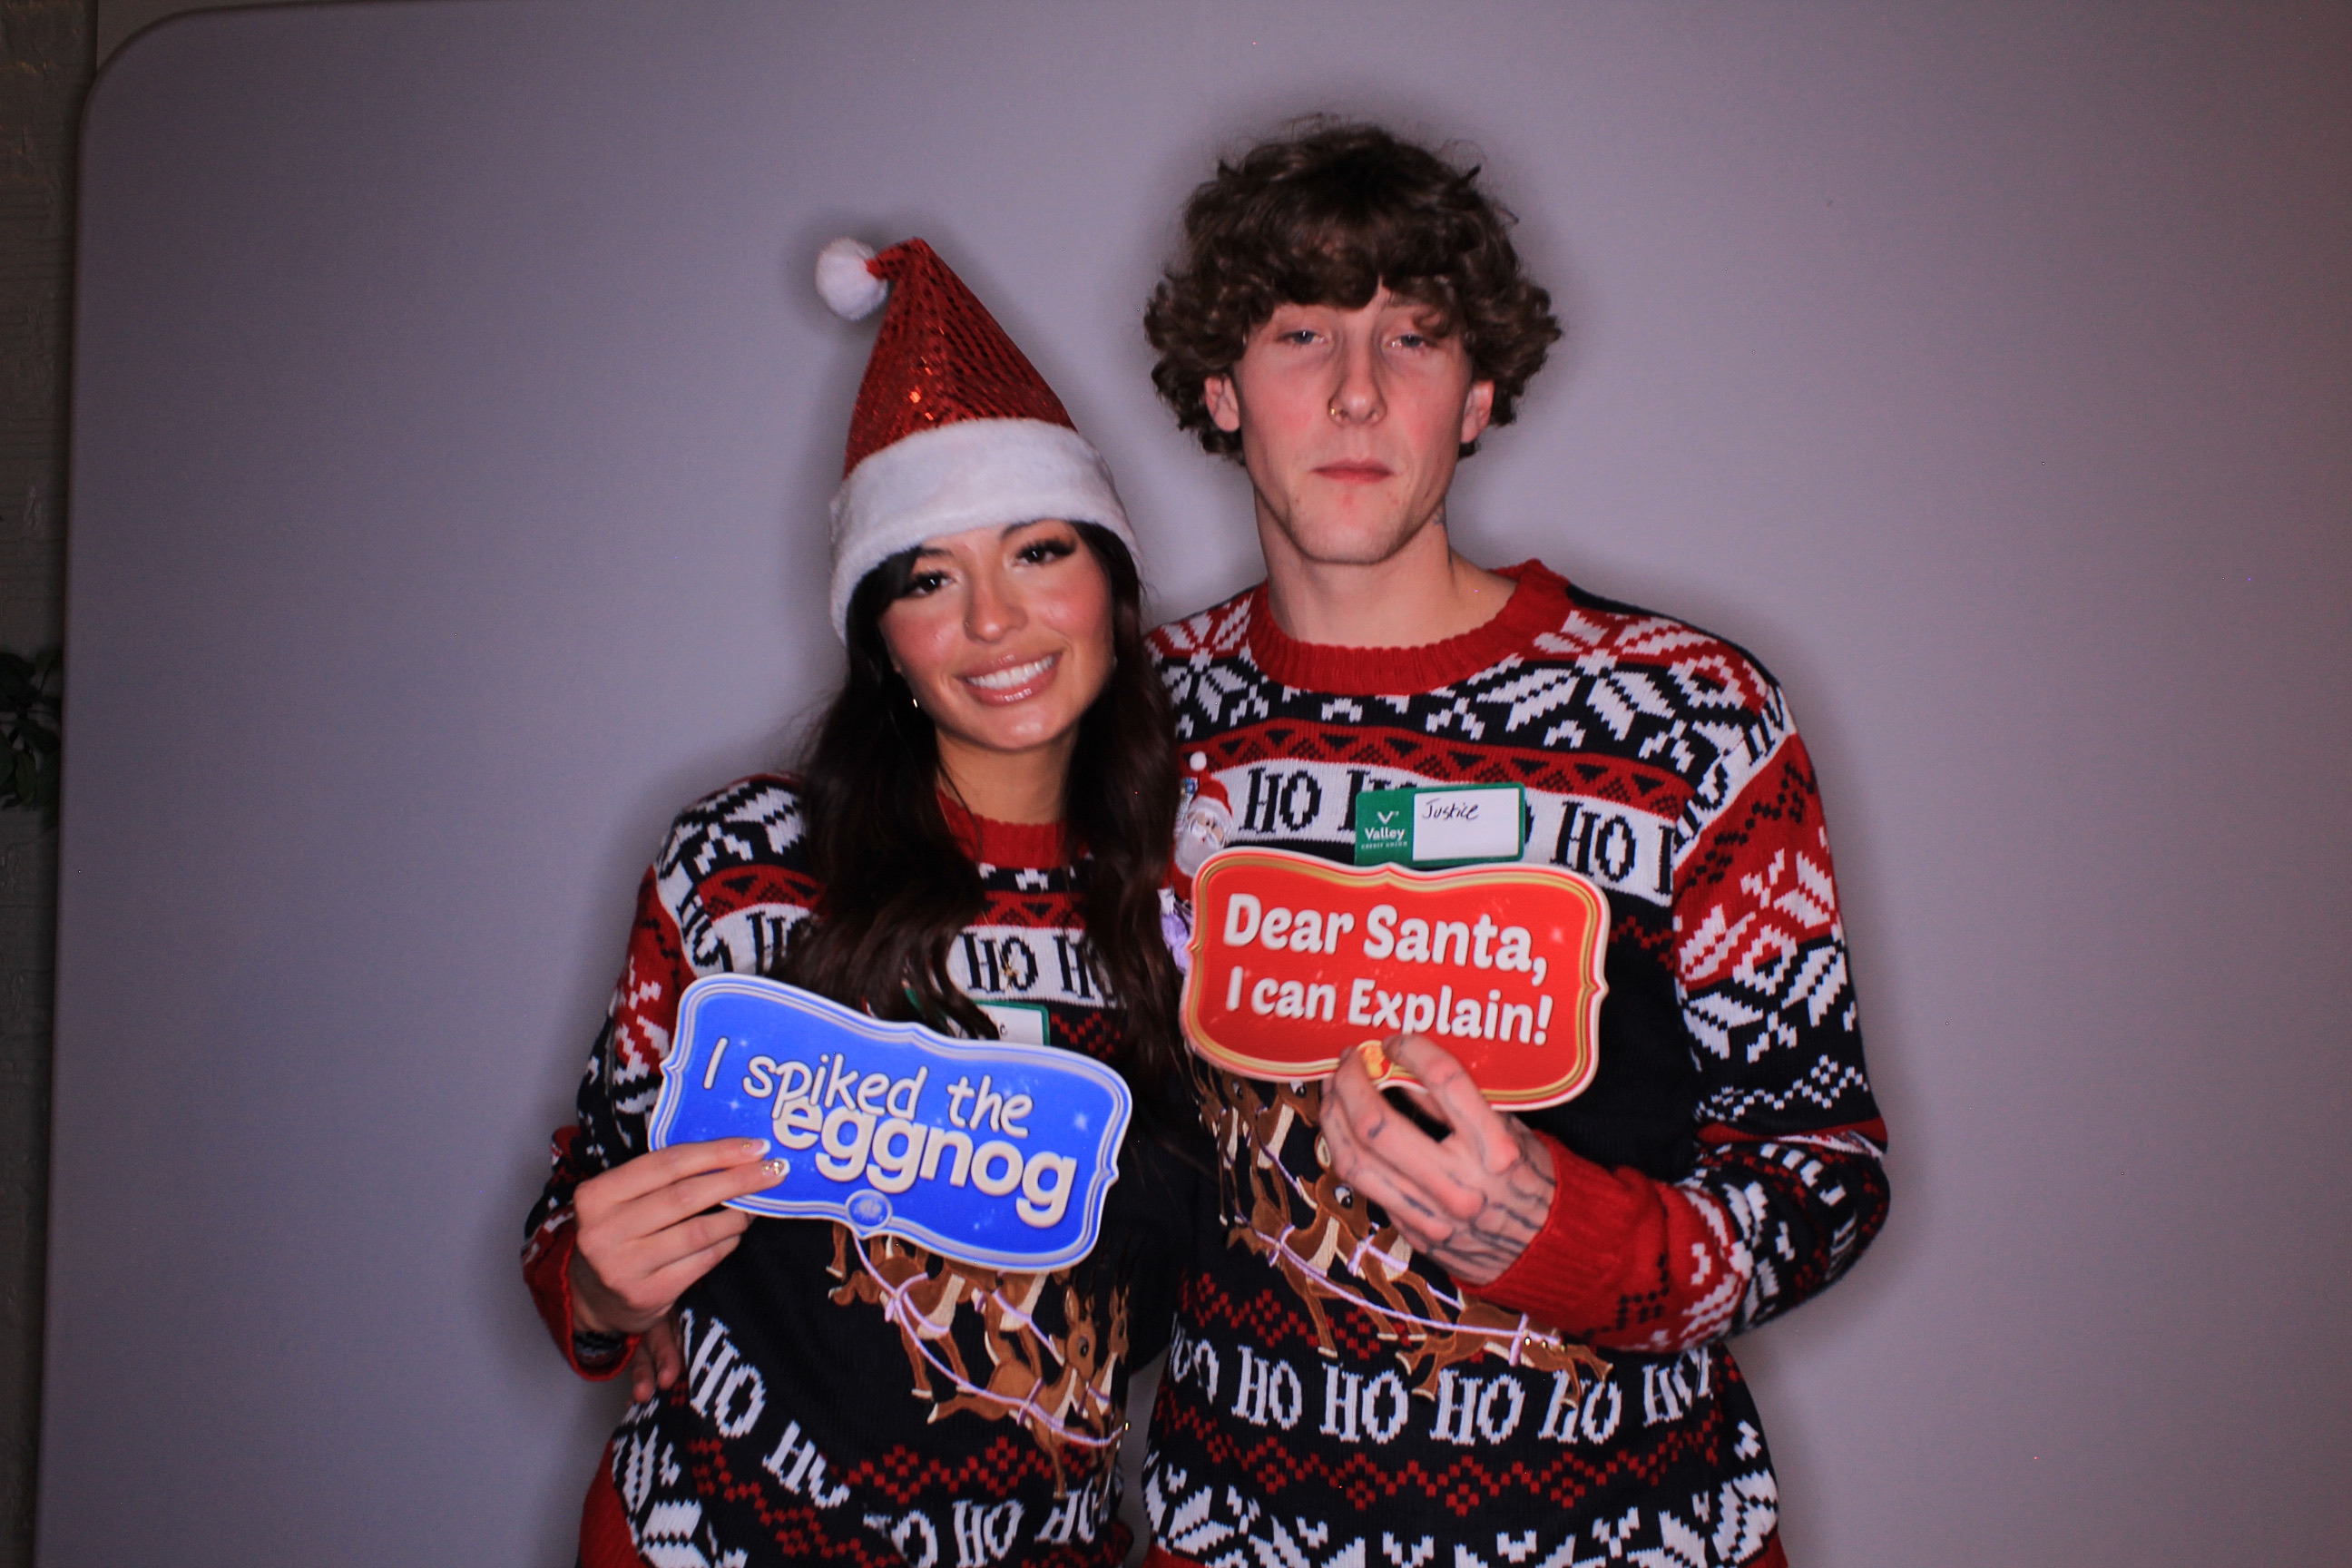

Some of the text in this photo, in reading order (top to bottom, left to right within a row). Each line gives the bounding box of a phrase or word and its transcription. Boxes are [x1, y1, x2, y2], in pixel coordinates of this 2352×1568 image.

[1239, 767, 1322, 832] HO
[1550, 801, 1636, 882] HO
[1364, 827, 1406, 842] Valley
[1422, 798, 1479, 821] Justice
[959, 933, 1039, 993] HO
[1054, 936, 1114, 1004] H
[1223, 893, 1548, 987] Dear Santa,
[1226, 965, 1553, 1046] I can Explain!
[703, 1036, 1034, 1139] I spiked the
[772, 1096, 1078, 1229] eggnog
[687, 1316, 767, 1439] HO
[953, 1499, 1025, 1568] HO
[1231, 1345, 1302, 1431] HO
[1319, 1362, 1409, 1445] HO
[1429, 1368, 1526, 1446] HO
[1538, 1369, 1622, 1445] HO
